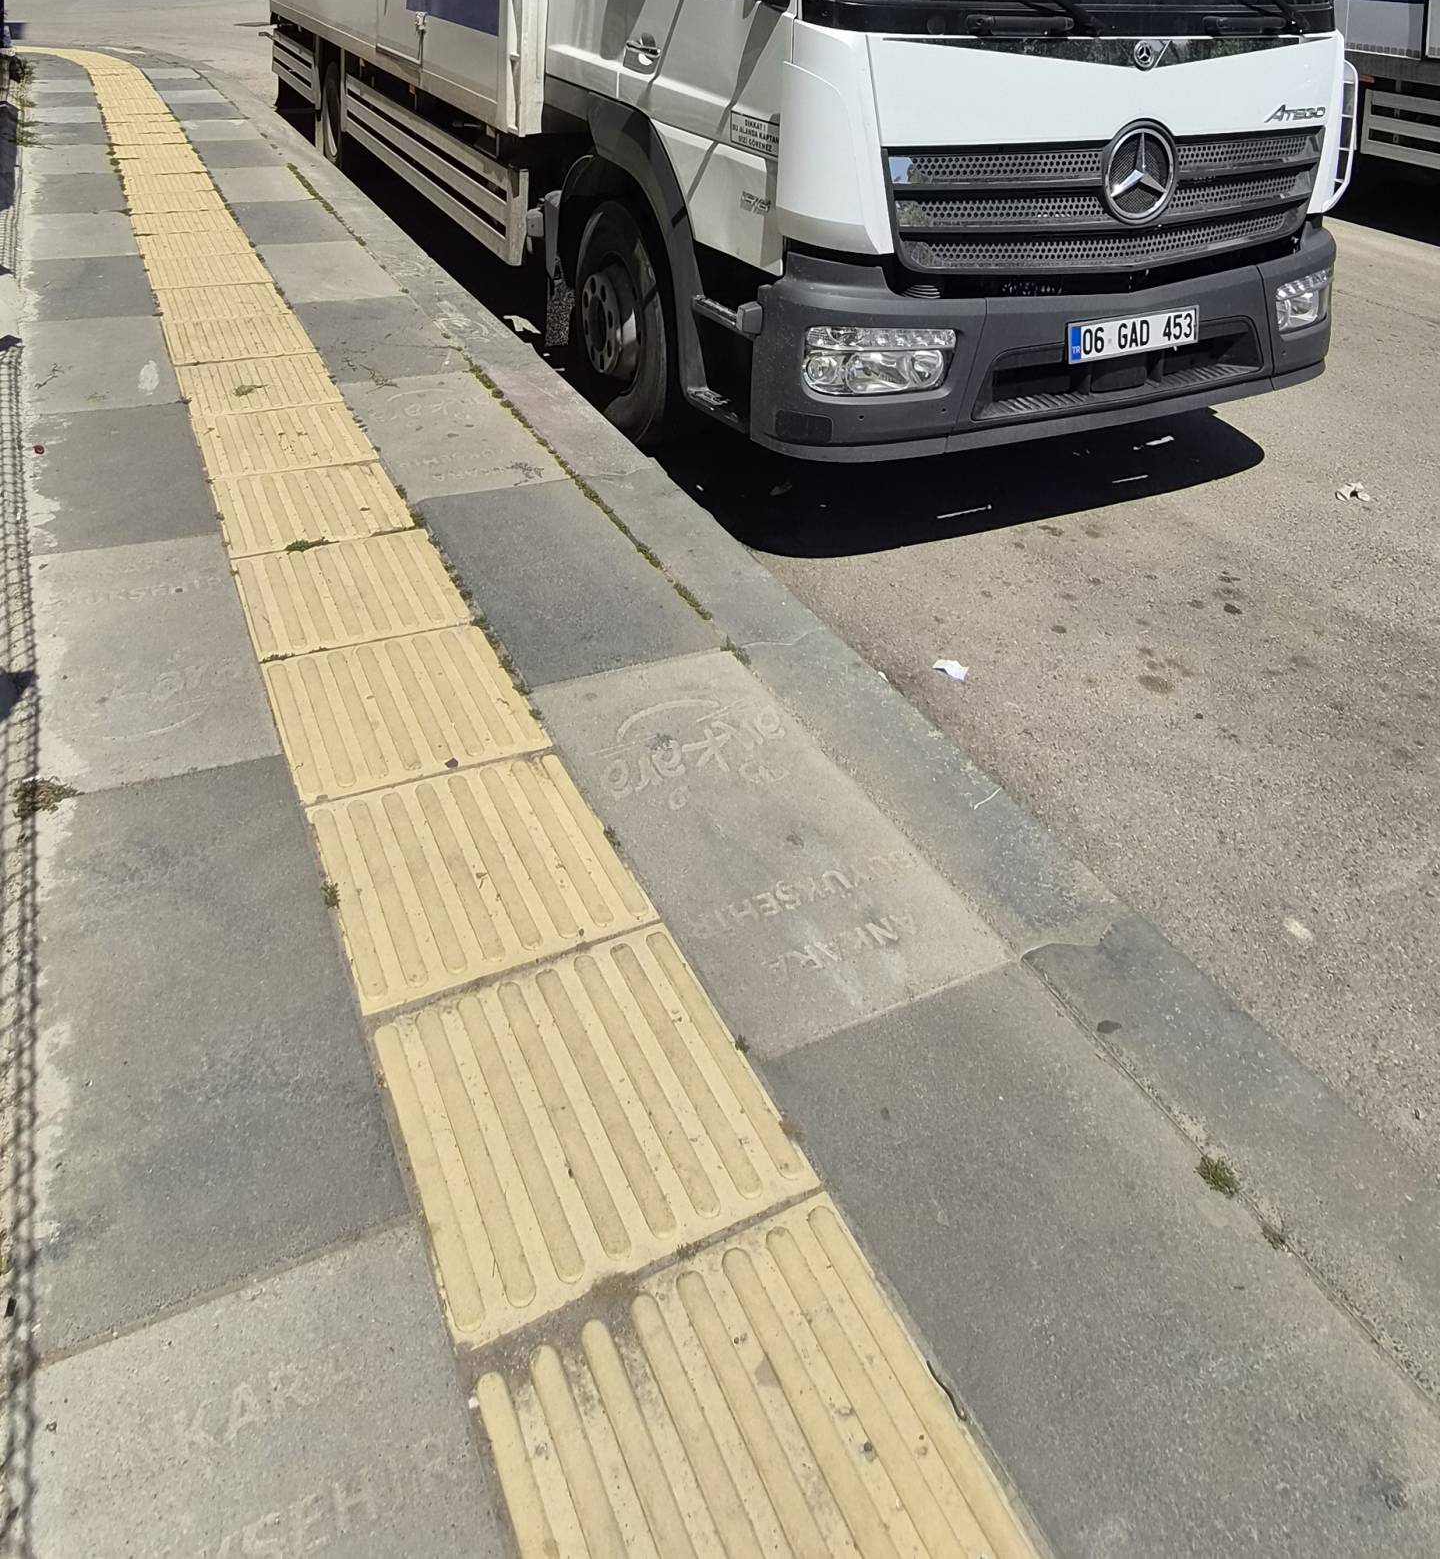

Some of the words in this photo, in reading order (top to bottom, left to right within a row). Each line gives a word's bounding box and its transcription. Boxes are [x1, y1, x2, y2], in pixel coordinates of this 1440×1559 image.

[1082, 326, 1105, 356] 06
[1117, 319, 1150, 350] GAD
[1163, 312, 1193, 342] 453
[1072, 345, 1081, 354] TR
